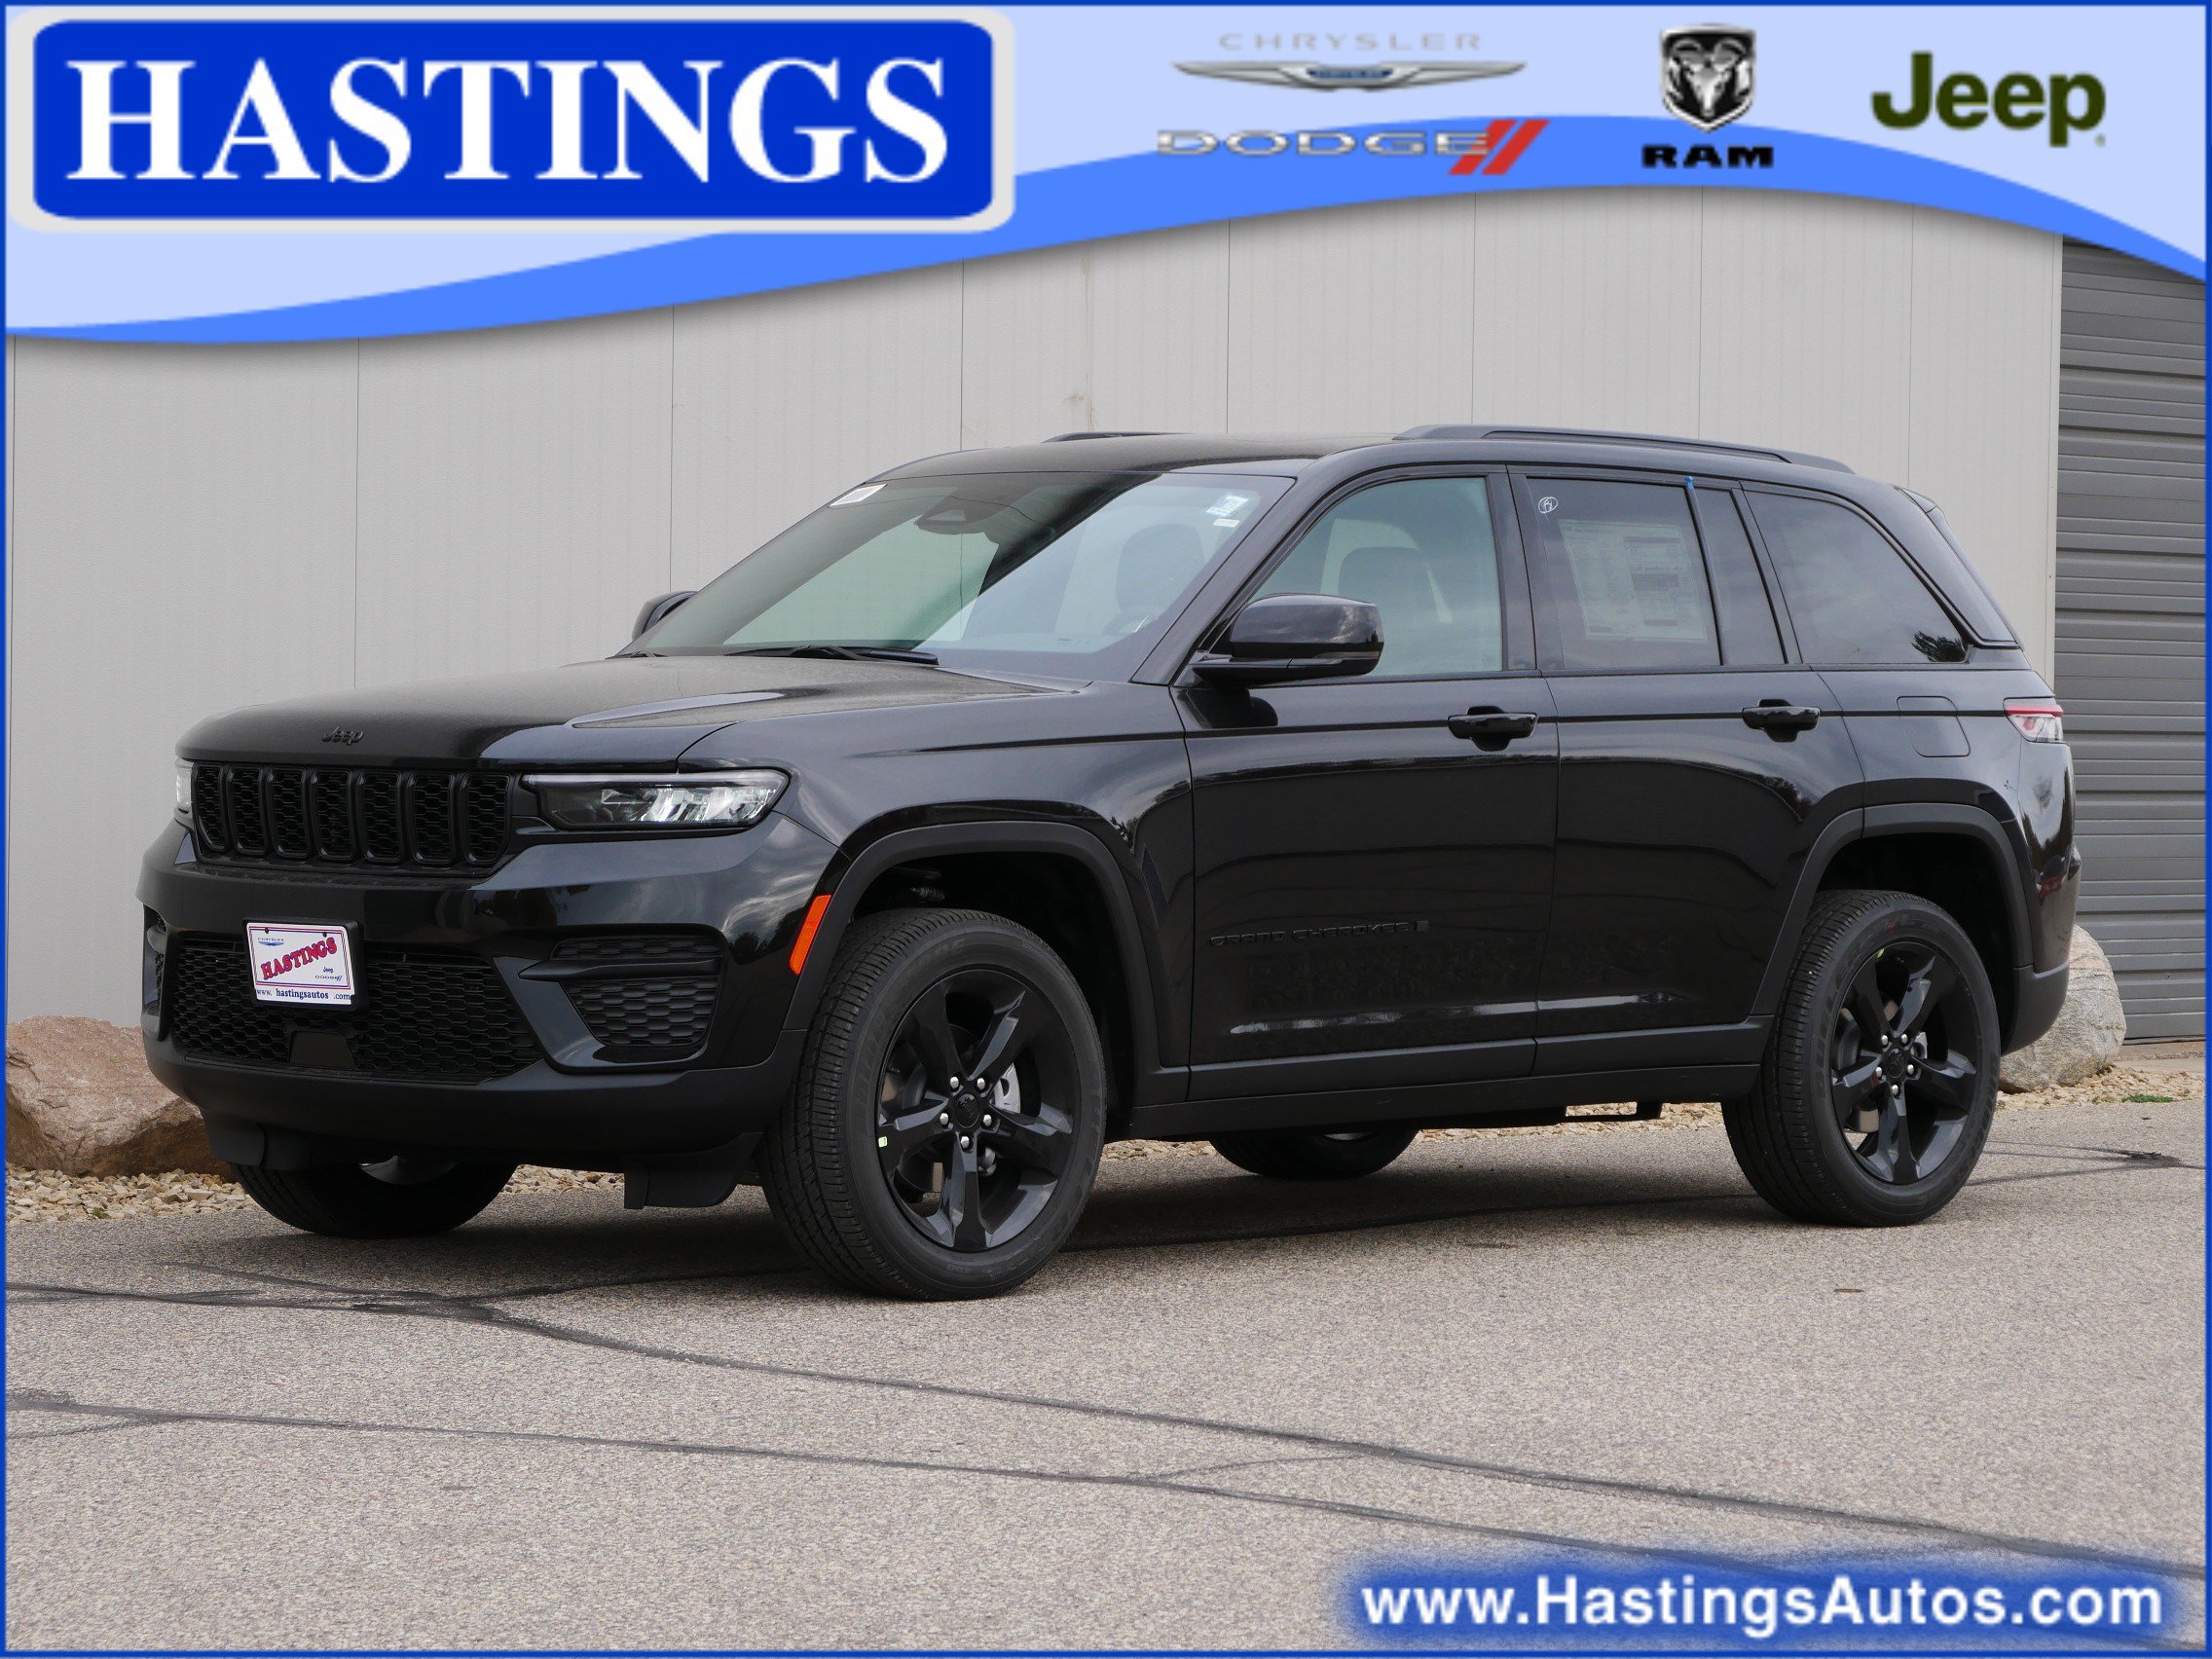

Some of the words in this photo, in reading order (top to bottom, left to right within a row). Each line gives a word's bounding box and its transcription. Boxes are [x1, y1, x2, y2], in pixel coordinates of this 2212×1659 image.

[321, 726, 364, 747] Jeep
[261, 937, 337, 980] HASTINGS
[276, 988, 329, 1000] hastingsautos
